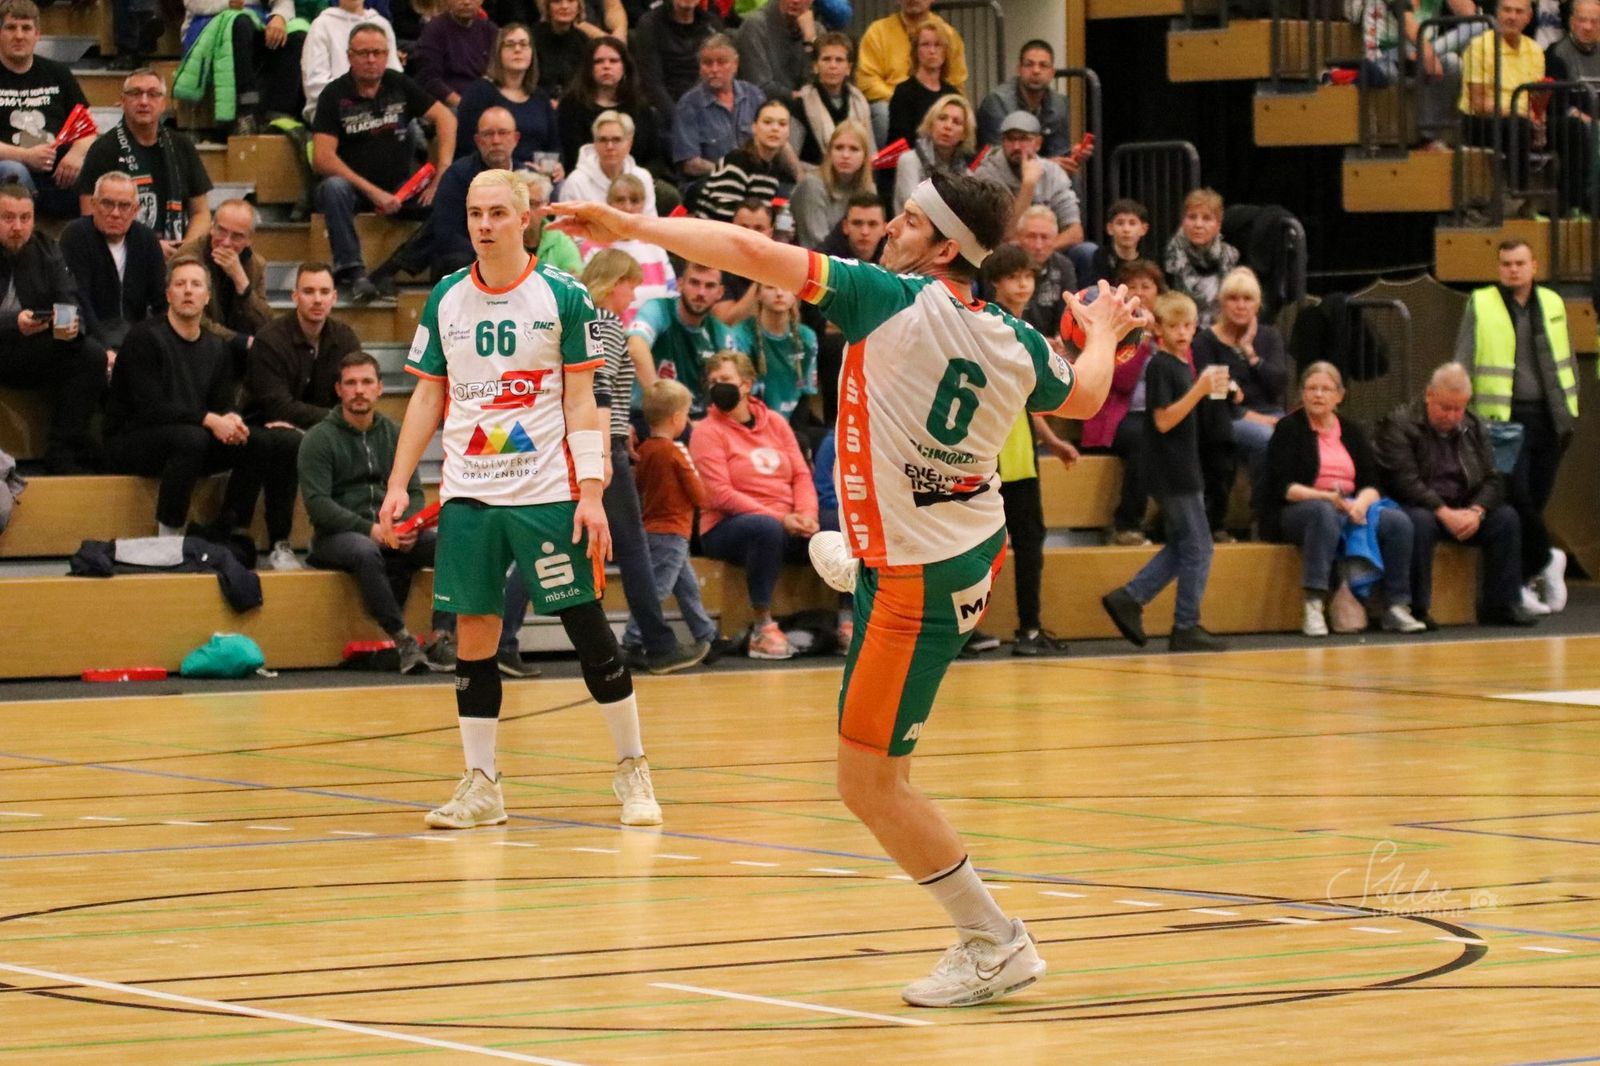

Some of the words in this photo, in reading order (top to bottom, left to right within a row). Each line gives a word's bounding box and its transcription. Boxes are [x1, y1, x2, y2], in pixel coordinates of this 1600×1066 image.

[475, 319, 517, 357] 66
[453, 379, 545, 402] ORAFOL
[926, 357, 988, 446] 6
[545, 587, 580, 602] mbs.de
